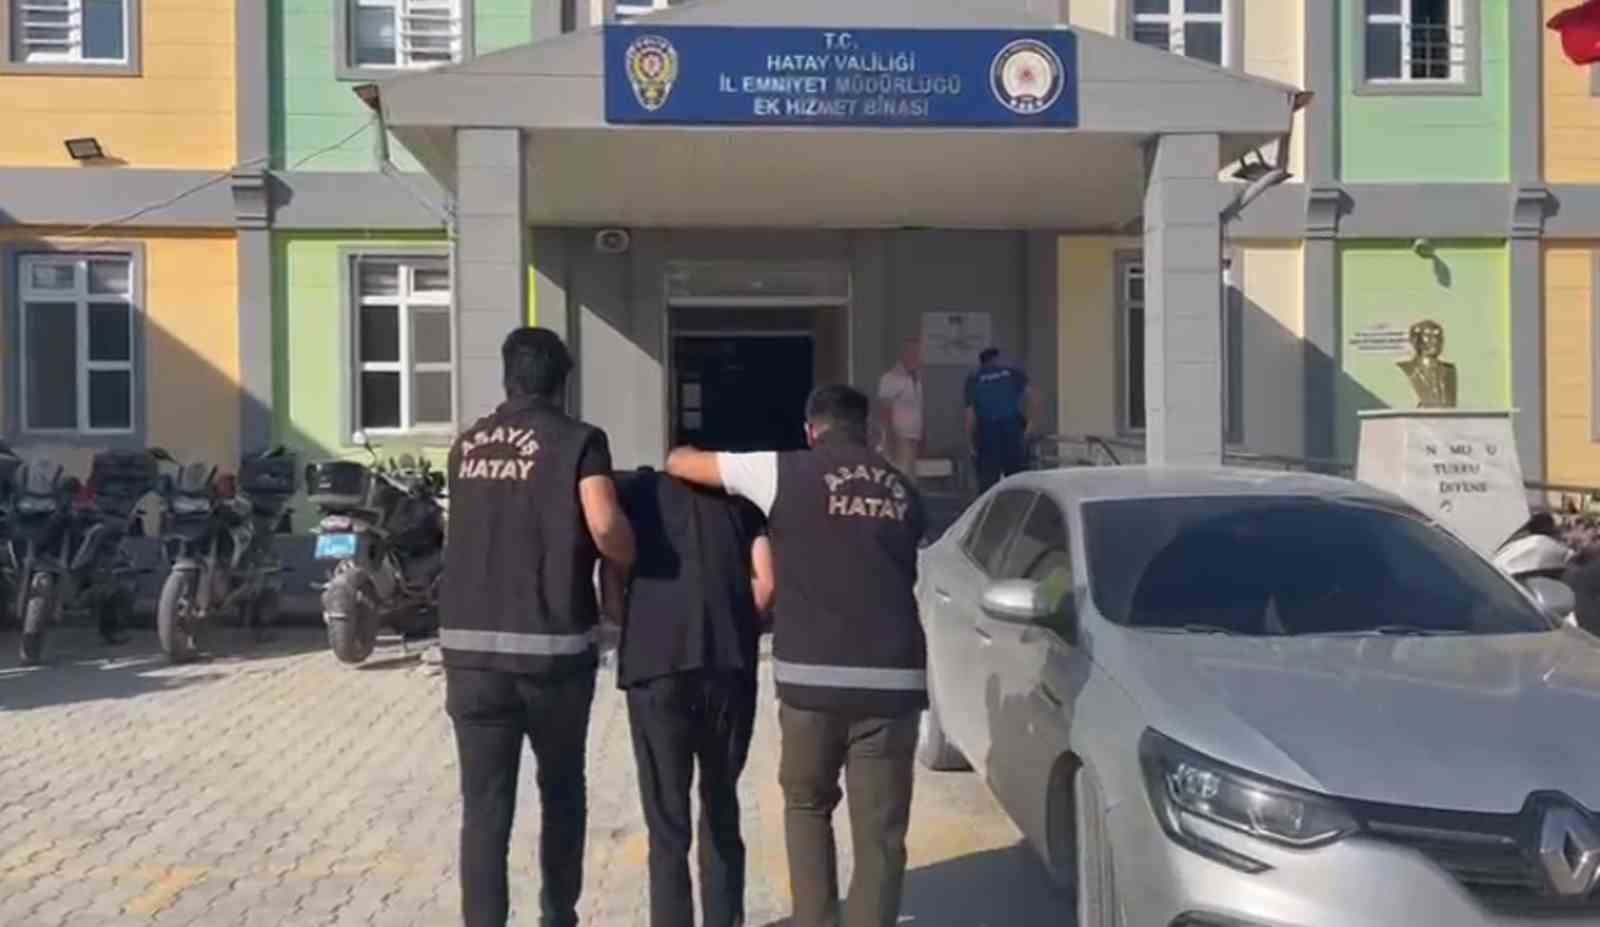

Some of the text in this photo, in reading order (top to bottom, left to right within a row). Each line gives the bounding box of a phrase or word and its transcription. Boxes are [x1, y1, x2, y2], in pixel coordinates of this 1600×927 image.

[823, 32, 859, 50] T.C.
[767, 55, 828, 72] HATAY
[754, 98, 780, 115] EK
[458, 459, 535, 479] HATAY
[828, 495, 908, 522] HATAY
